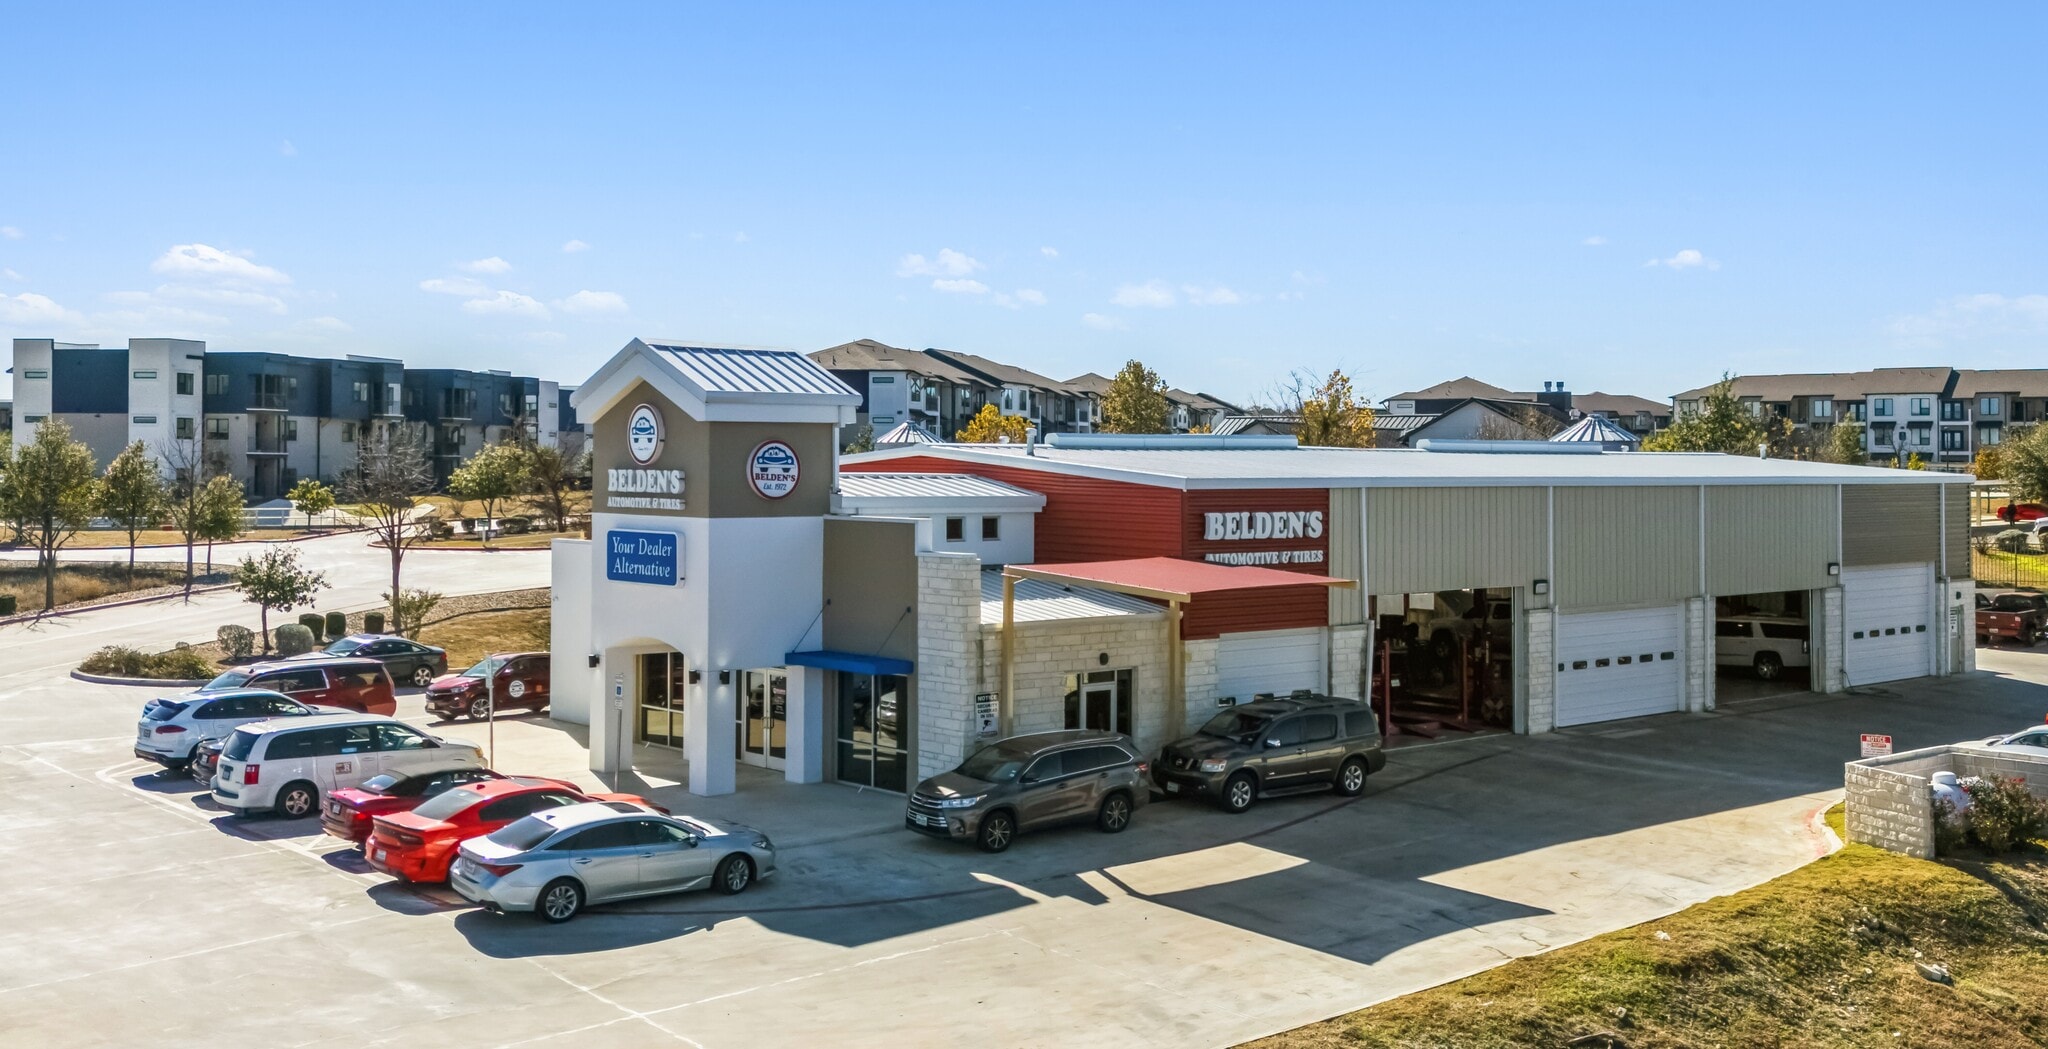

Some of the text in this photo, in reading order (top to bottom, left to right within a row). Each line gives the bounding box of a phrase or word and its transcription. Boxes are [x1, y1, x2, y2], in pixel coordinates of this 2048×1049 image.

[607, 469, 681, 494] BELDEN'S
[755, 472, 796, 482] BELDEN'S
[774, 483, 787, 491] 1972
[607, 496, 681, 510] AUTOMOTIVE & TIRES
[1204, 511, 1323, 540] BELDEN'S
[612, 536, 672, 557] Your Dealer
[613, 556, 670, 577] Alternative
[1205, 550, 1324, 565] AUTOMOTIVE & TIRES
